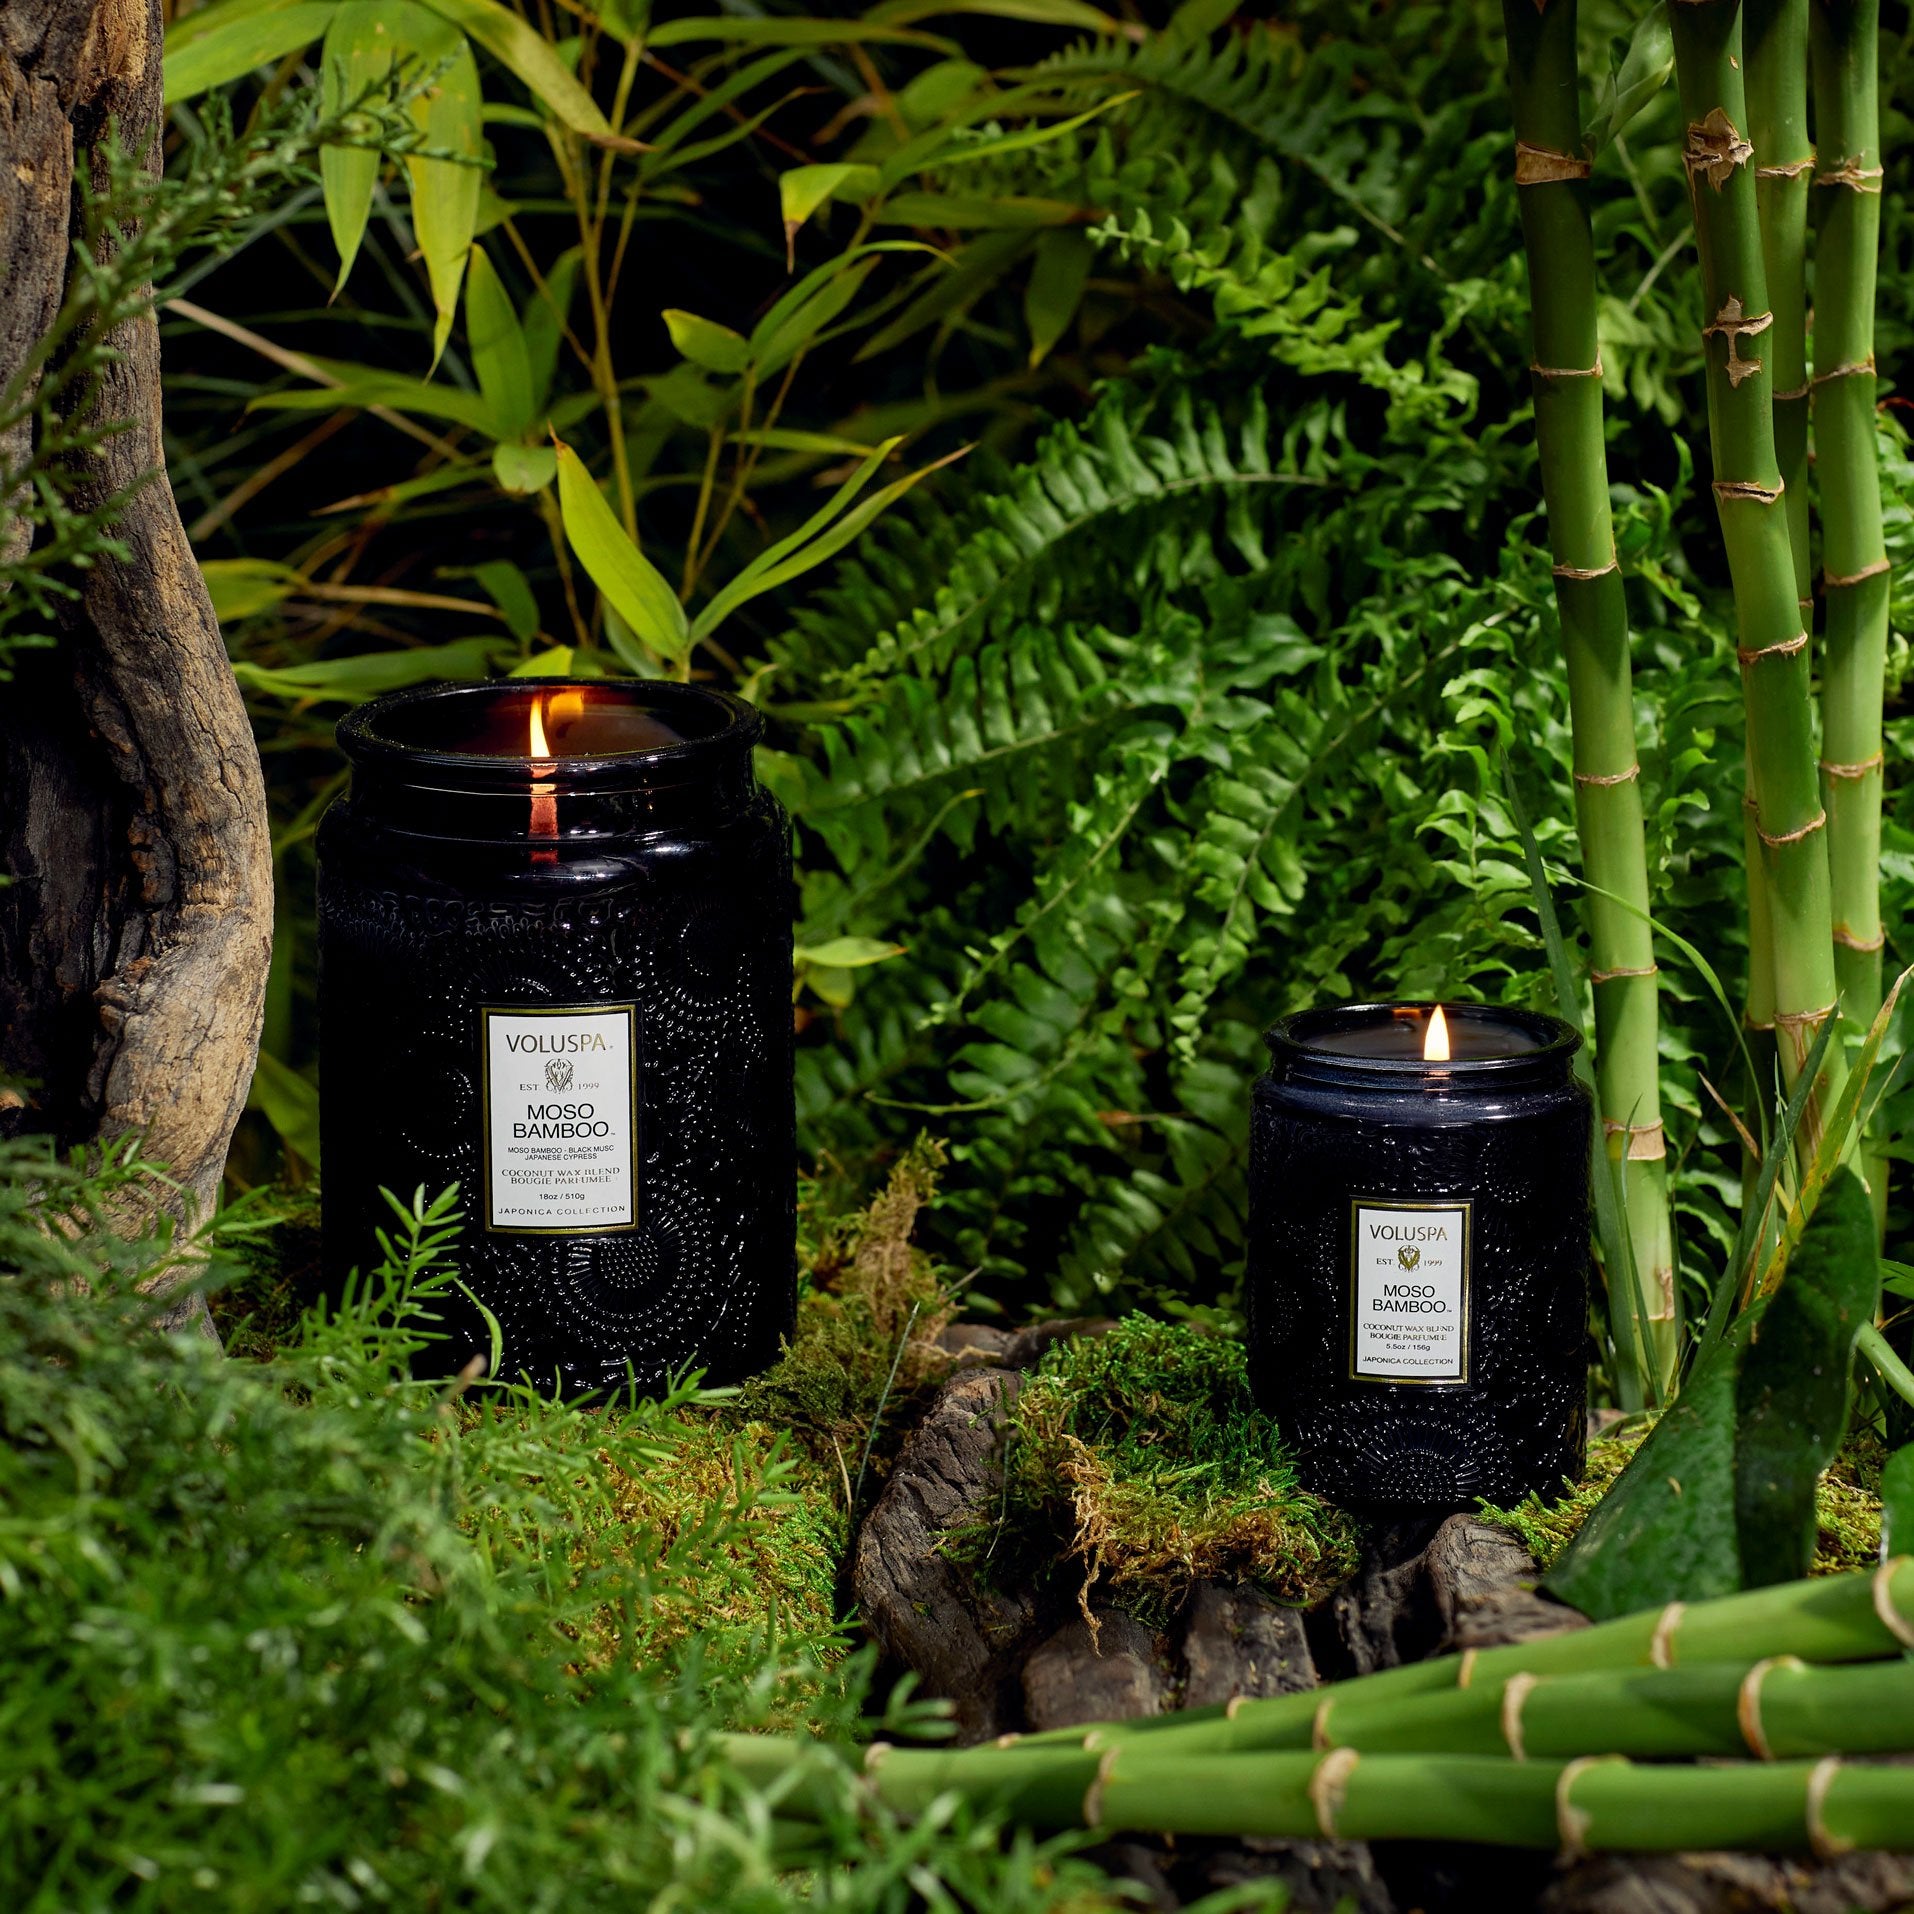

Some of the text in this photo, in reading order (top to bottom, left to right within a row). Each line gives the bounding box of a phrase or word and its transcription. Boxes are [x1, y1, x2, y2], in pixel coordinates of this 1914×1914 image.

[506, 1033, 607, 1053] VOLUSPA
[527, 1103, 595, 1120] MOSO
[501, 1167, 621, 1177] COCONUT WAX BLEND
[511, 1177, 552, 1185] BOUGIE
[565, 1193, 585, 1201] 510g
[556, 1205, 626, 1215] COLLECTION
[1369, 1224, 1448, 1241] VOLUSPA
[1383, 1284, 1436, 1298] MOSO
[1363, 1323, 1404, 1332] COCONUT
[1370, 1332, 1401, 1341] BOUGIE
[1362, 1356, 1454, 1366] JAPONICA COLLECTION
